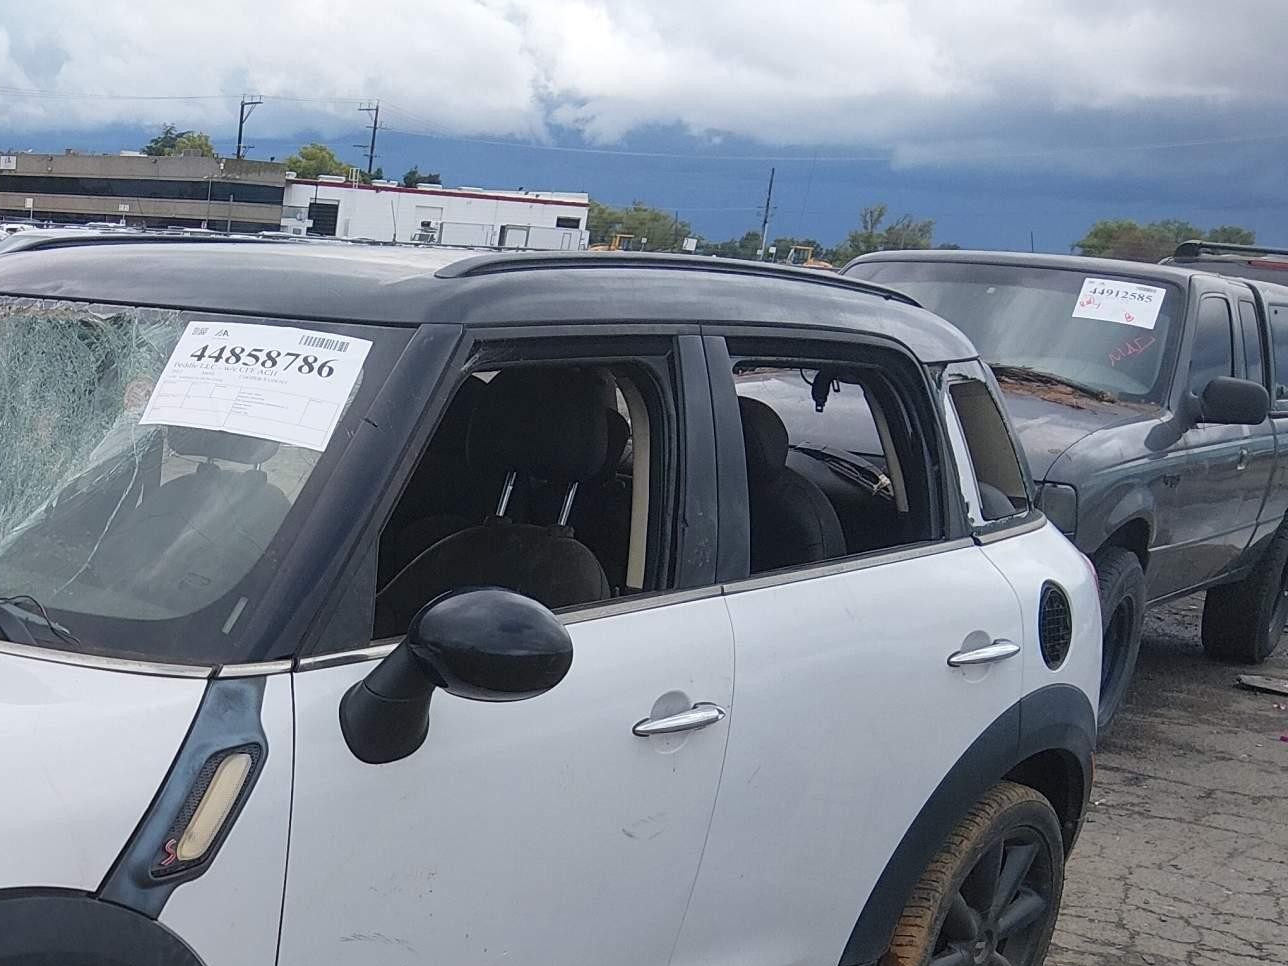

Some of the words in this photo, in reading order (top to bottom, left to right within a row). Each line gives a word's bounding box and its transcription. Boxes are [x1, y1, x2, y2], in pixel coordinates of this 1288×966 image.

[1089, 287, 1153, 303] 44912585
[190, 344, 340, 378] 44858786
[161, 838, 177, 866] S
